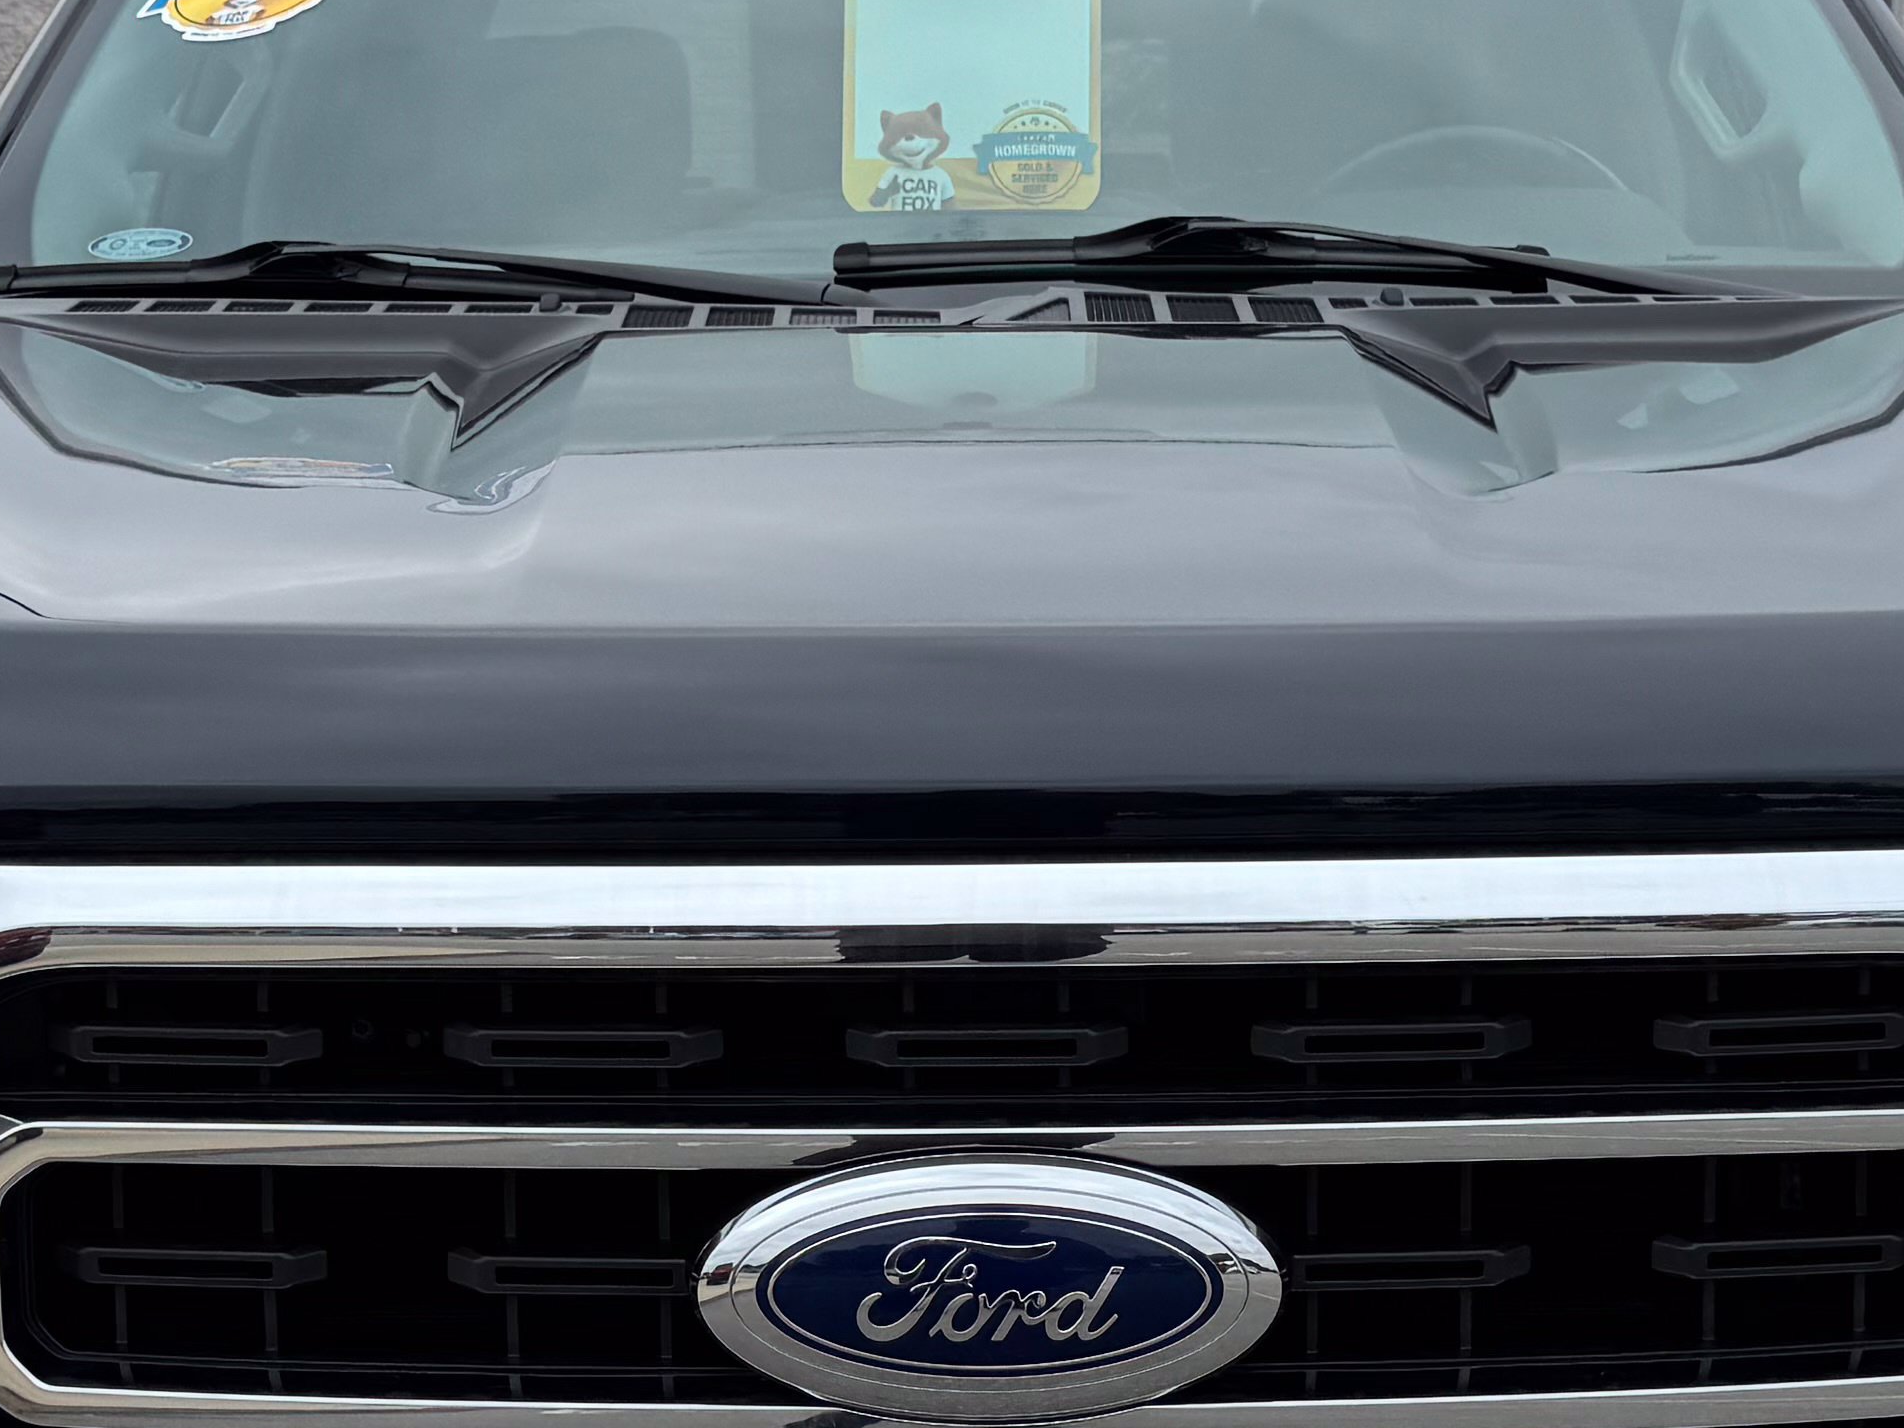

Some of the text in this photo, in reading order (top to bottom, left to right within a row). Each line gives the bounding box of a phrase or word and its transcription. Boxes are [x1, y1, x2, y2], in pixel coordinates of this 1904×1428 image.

[994, 143, 1076, 158] HOMEGROWN
[902, 177, 938, 194] CAR
[902, 196, 936, 211] FOX
[856, 1236, 1124, 1341] Ford
